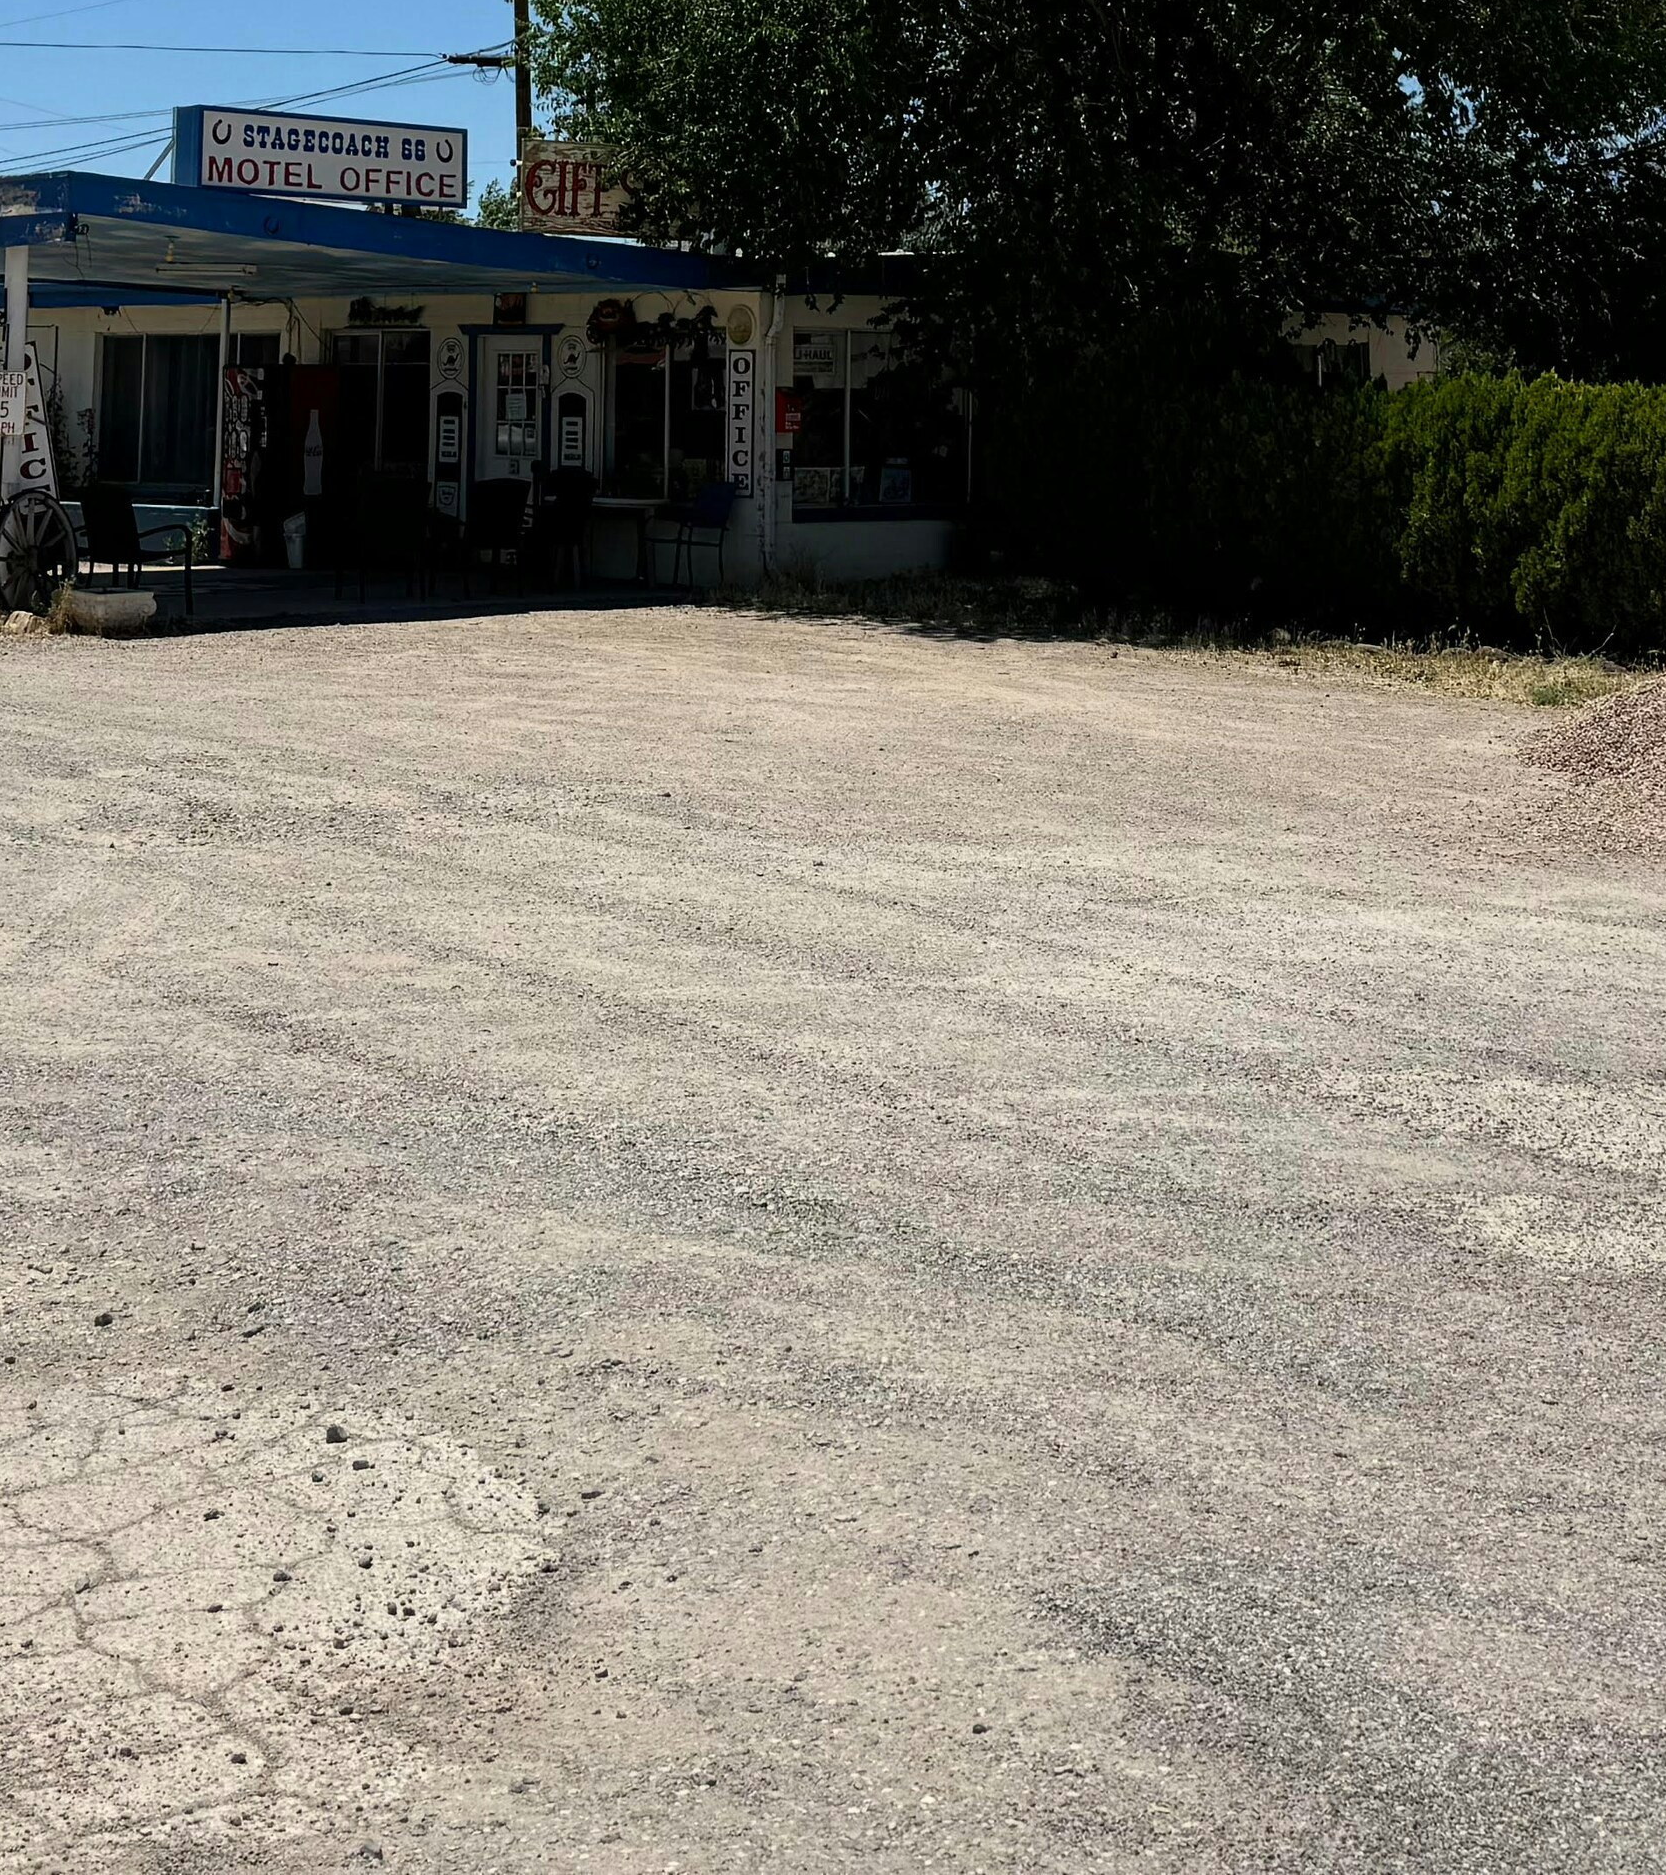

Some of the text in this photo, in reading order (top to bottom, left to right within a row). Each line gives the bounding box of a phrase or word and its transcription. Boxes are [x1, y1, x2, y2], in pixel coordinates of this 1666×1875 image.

[243, 124, 426, 162] STAGECOACH 66
[208, 156, 457, 199] MOTEL OFFICE
[0, 401, 9, 418] 5
[732, 357, 751, 491] OFFICE
